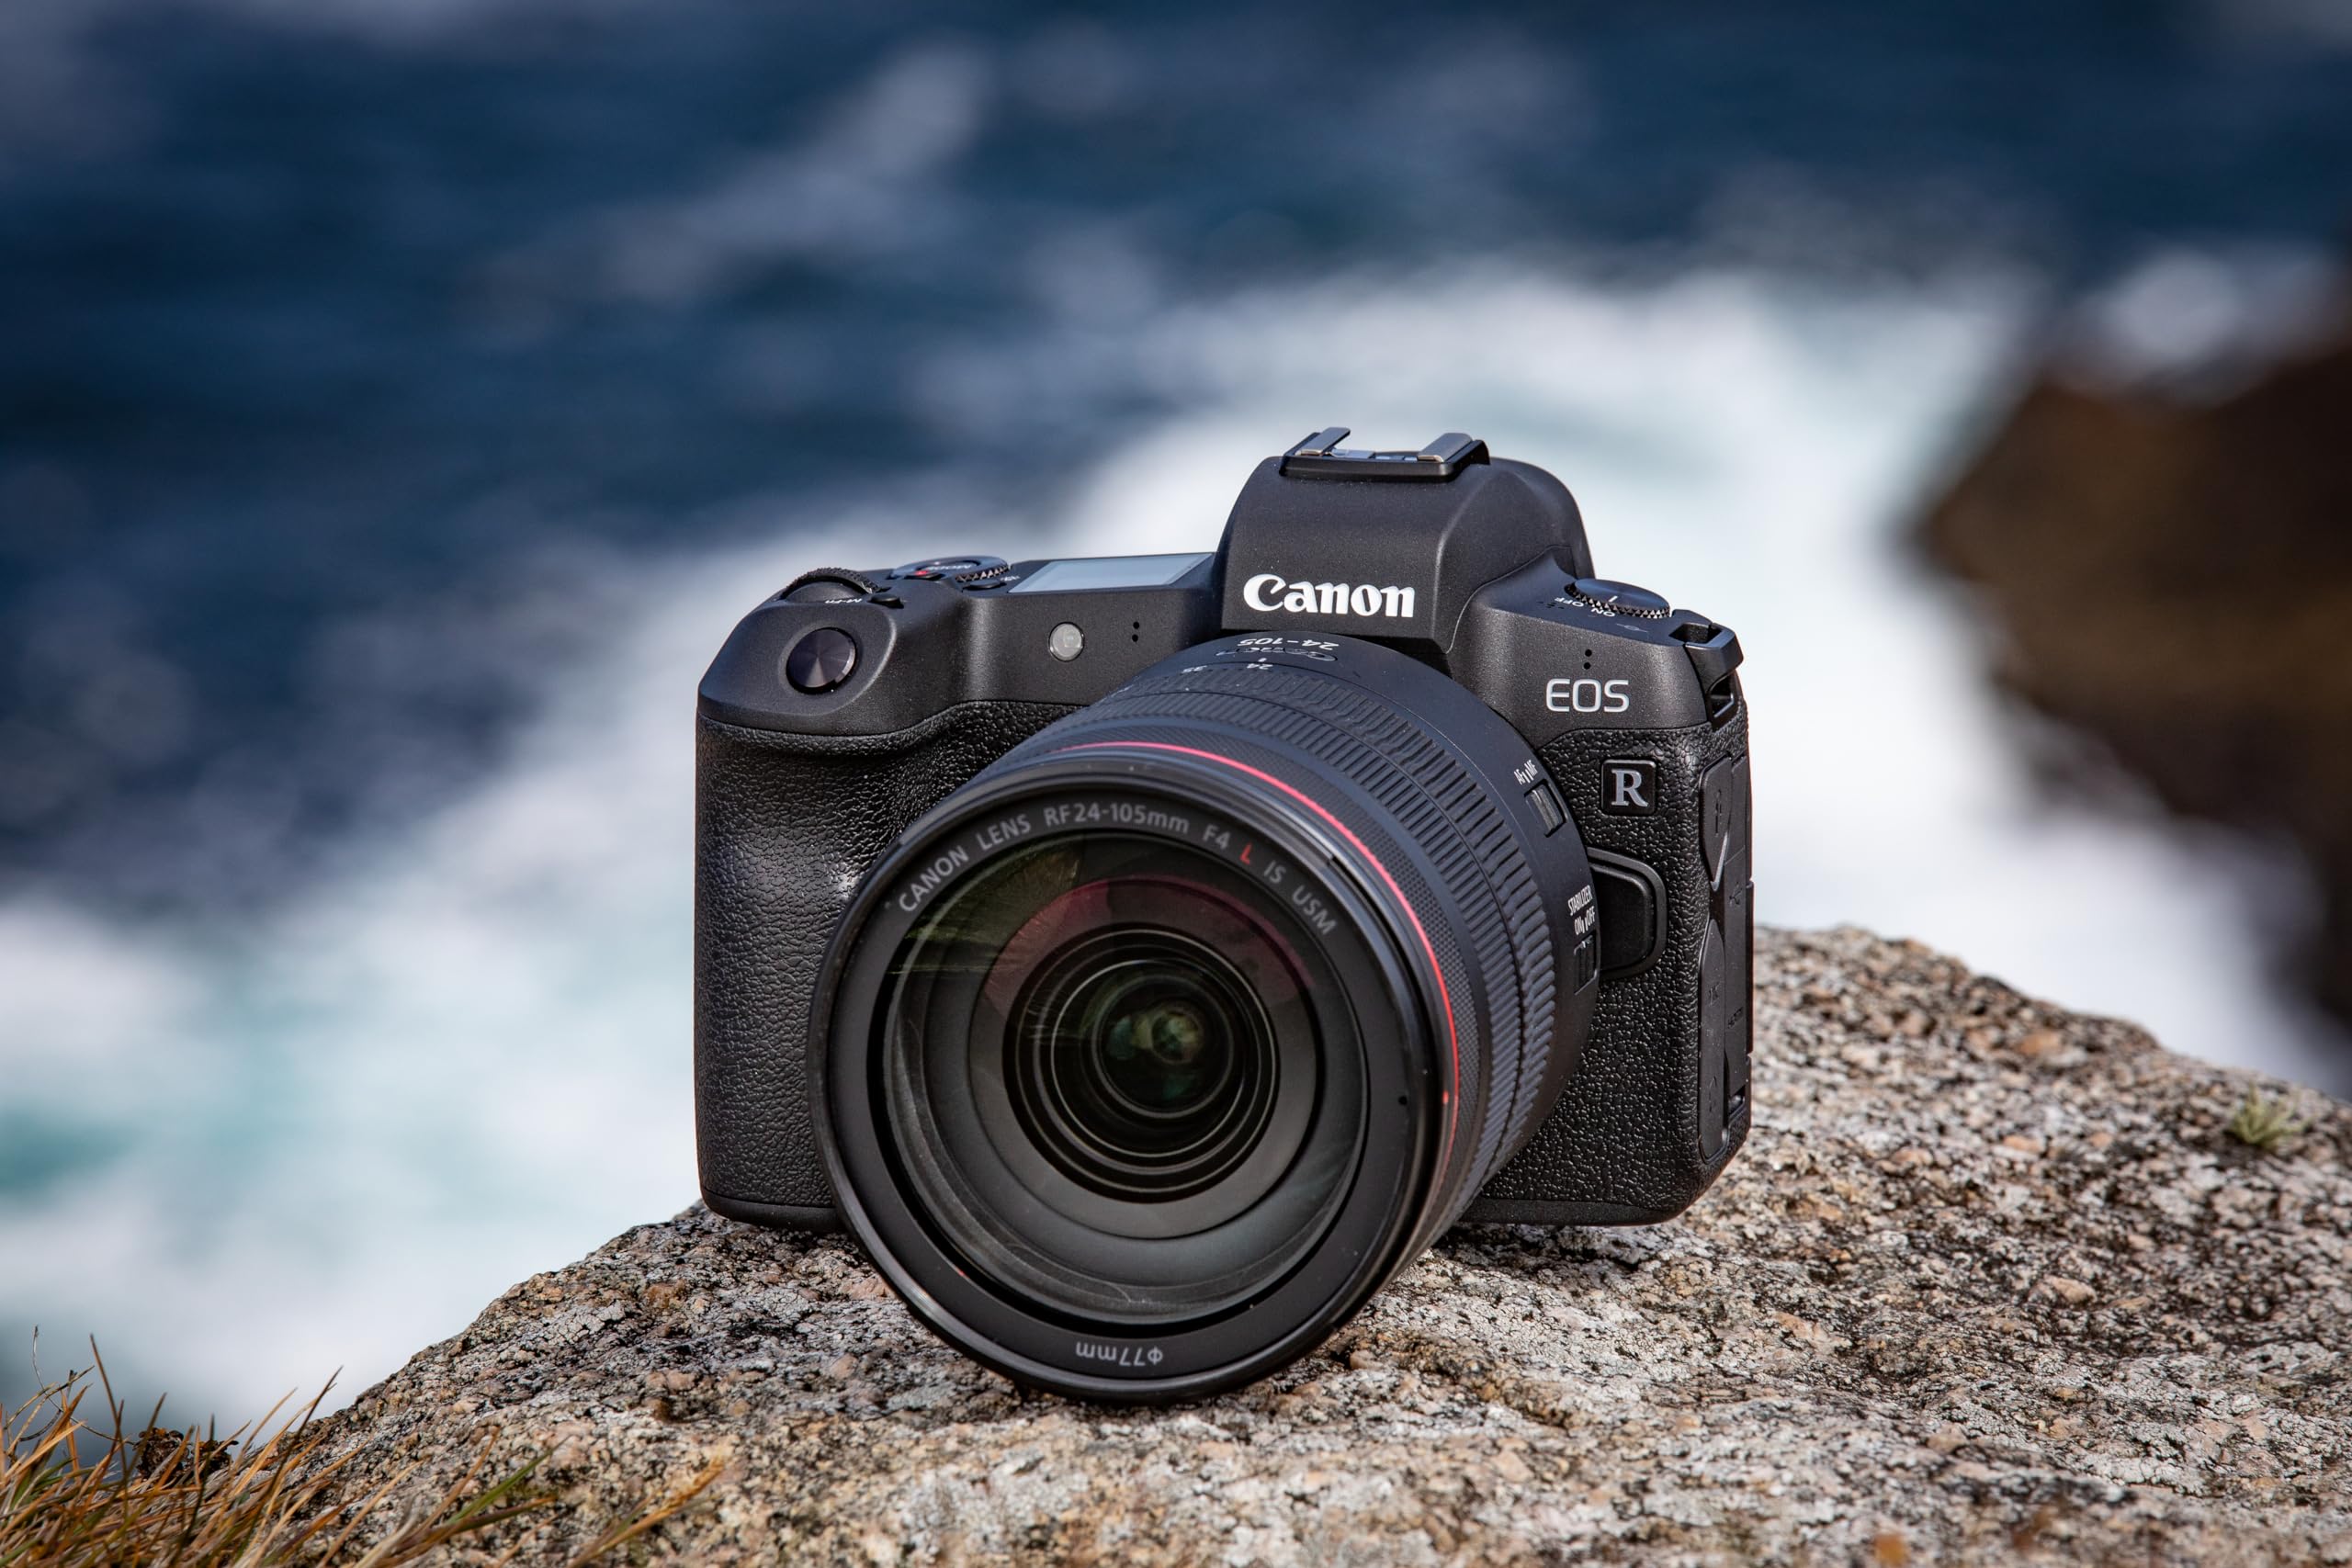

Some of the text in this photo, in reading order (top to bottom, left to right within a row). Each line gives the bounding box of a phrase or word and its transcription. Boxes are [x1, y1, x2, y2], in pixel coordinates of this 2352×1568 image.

[1243, 573, 1416, 618] Canon
[1554, 596, 1585, 607] OFF
[1590, 607, 1616, 617] ON
[1237, 637, 1340, 650] 24-105
[1246, 662, 1273, 671] 24
[1545, 678, 1630, 713] EOS
[1611, 768, 1649, 807] R
[898, 844, 969, 912] CANON
[974, 813, 1032, 852] LENS
[1202, 823, 1232, 851] F4
[1239, 840, 1253, 865] L
[1263, 859, 1286, 885] IS
[1292, 884, 1338, 936] USM
